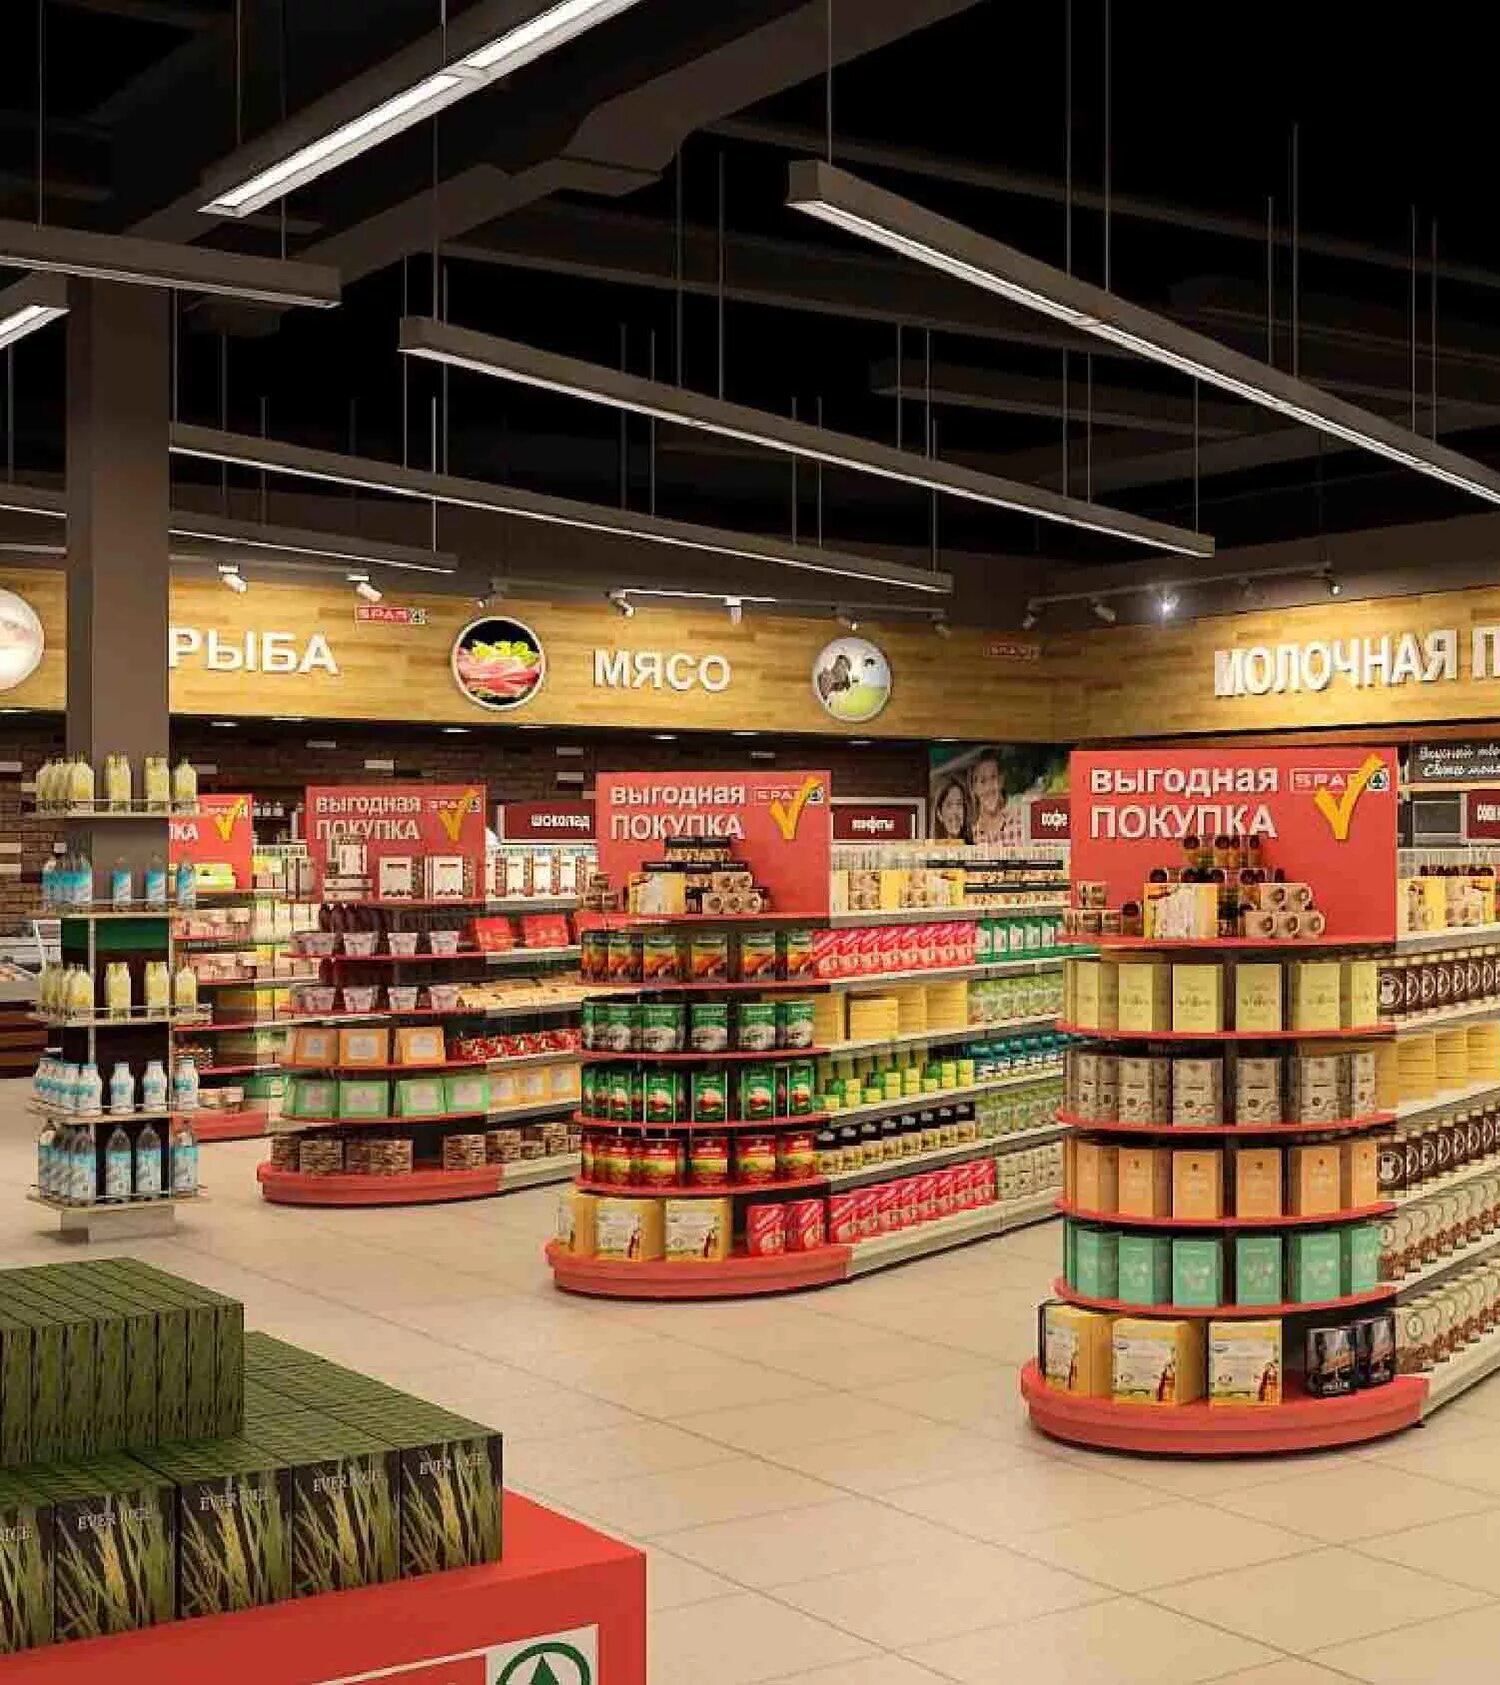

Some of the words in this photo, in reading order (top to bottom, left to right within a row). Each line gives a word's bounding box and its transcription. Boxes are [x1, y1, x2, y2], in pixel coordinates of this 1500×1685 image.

[168, 628, 339, 675] РЫБА
[1214, 629, 1458, 698] МОЛОЧНАЯ
[593, 648, 731, 693] МЯСО
[610, 786, 744, 806] выгодная
[1090, 768, 1279, 799] выгодная
[316, 796, 420, 815] выгодная
[316, 819, 419, 840] ПОКУПКА
[531, 815, 590, 831] шоколад
[610, 814, 745, 839] ПОКУПКА
[1090, 804, 1279, 839] ПОКУПКА
